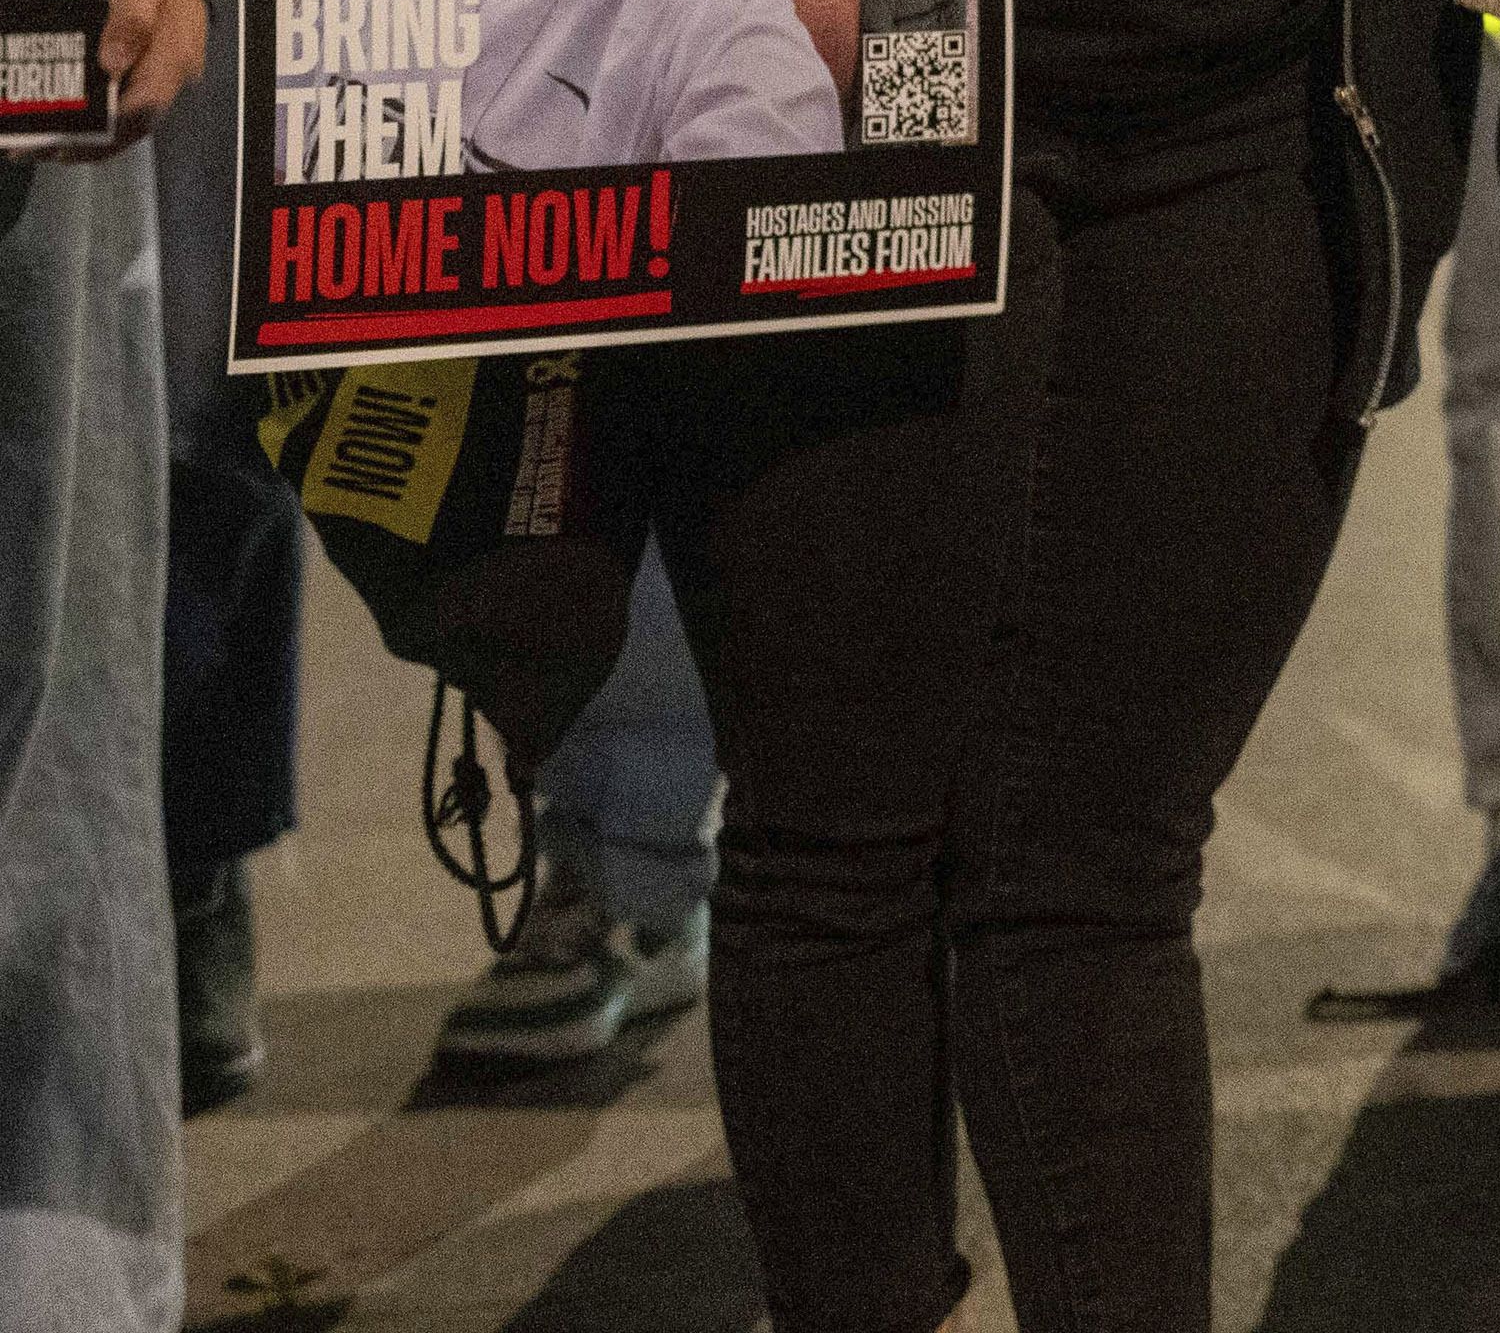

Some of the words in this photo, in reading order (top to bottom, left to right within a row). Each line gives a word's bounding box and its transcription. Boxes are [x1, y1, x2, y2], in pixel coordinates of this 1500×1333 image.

[276, 80, 464, 185] THEM
[269, 197, 462, 302] HOME
[483, 171, 670, 288] NOW!
[744, 232, 868, 283] FAMILIES
[875, 224, 972, 274] FORUM
[747, 202, 845, 237] HOSTAGES
[848, 199, 888, 229] AND
[891, 193, 973, 226] MISSING
